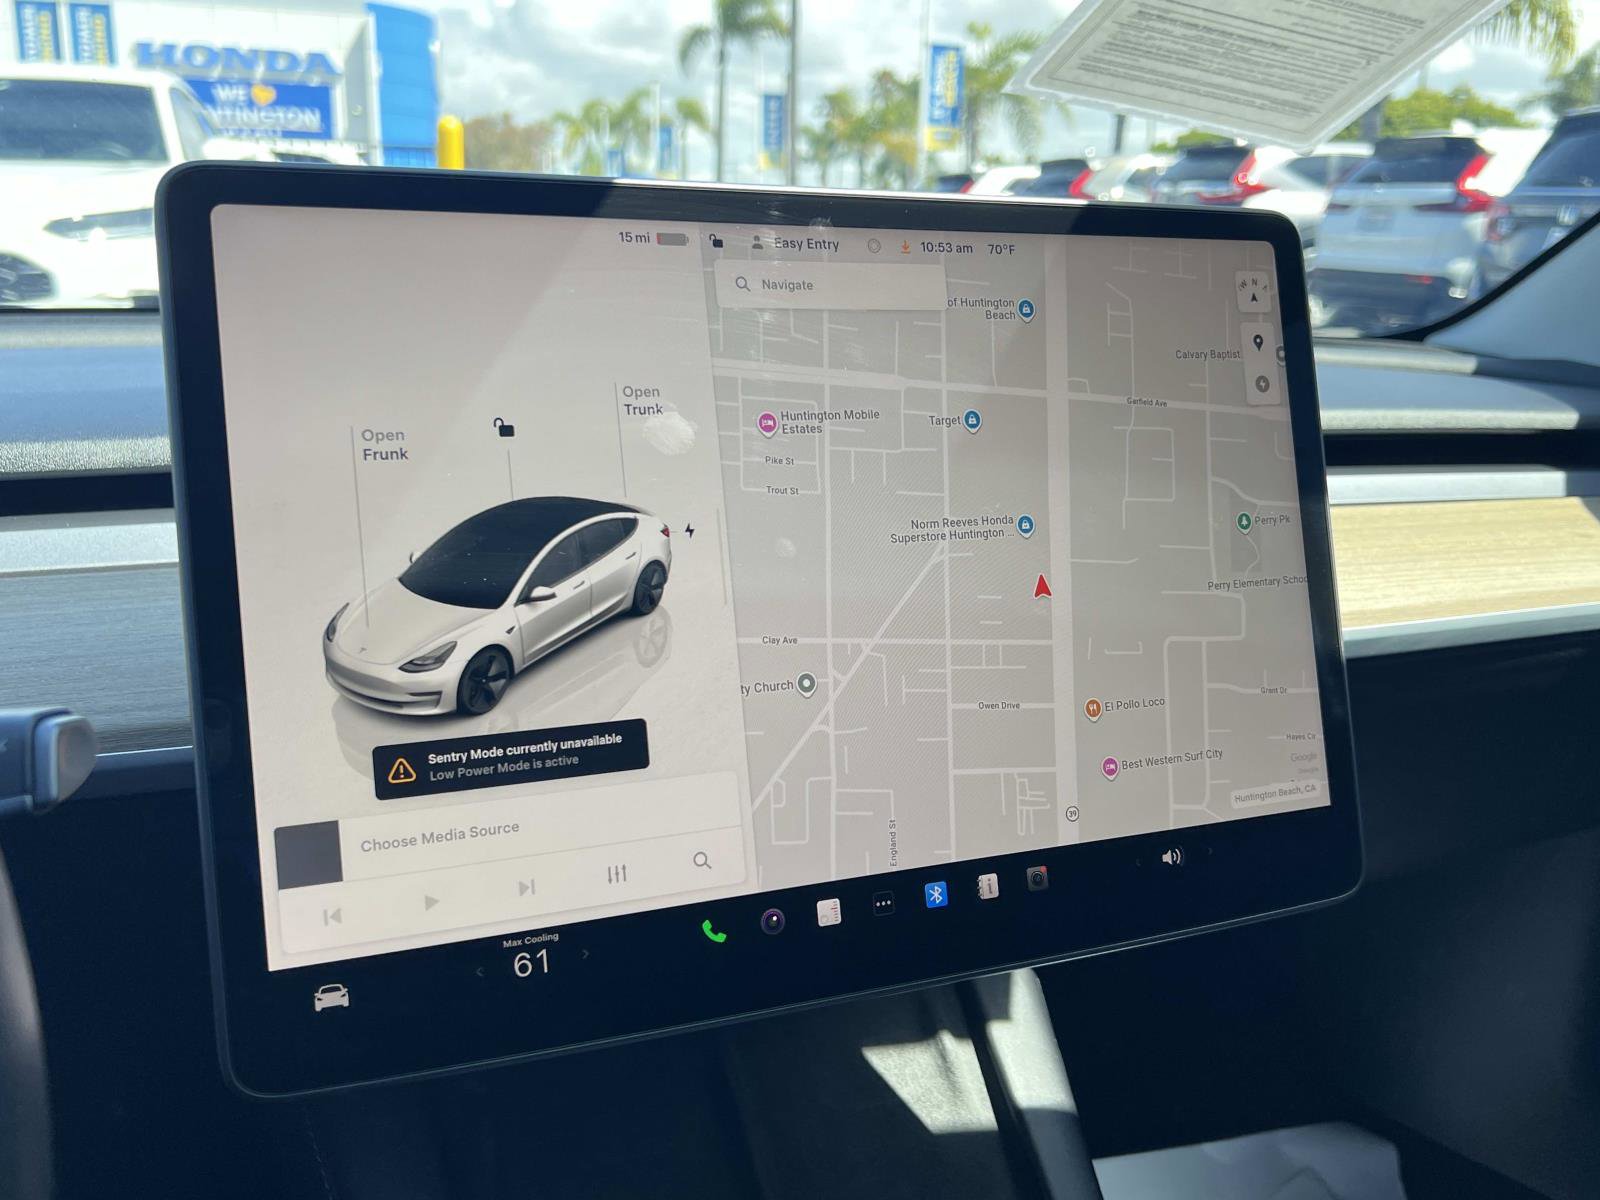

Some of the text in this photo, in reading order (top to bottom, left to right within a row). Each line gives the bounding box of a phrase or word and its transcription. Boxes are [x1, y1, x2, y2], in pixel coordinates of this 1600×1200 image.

[135, 42, 342, 75] HONDA
[212, 84, 248, 102] WE
[619, 231, 651, 244] 15 mi
[774, 237, 839, 252] Easy Entry
[920, 240, 974, 255] 10:53 am
[988, 243, 1015, 256] 70°F
[761, 278, 814, 293] Navigate
[947, 297, 1015, 310] of Huntington
[985, 309, 1016, 320] Beach
[1175, 350, 1241, 361] Calvary Baptist
[623, 385, 661, 399] Open
[624, 403, 663, 416] Trunk
[1155, 399, 1168, 408] Ave
[780, 409, 880, 423] Huntington Mobile
[928, 415, 962, 428] Target
[782, 423, 823, 435] Estates
[361, 428, 405, 445] Open
[363, 447, 409, 461] Frunk
[765, 455, 795, 466] Pike St
[766, 485, 799, 496] Trout St
[911, 515, 1014, 530] Norm Reeves Honda
[1254, 514, 1291, 526] Perry Pk
[890, 531, 947, 545] Superstore
[949, 529, 1005, 542] Huntington
[1207, 580, 1231, 591] Perry
[1233, 577, 1281, 589] Elementary
[762, 635, 798, 645] Clay Ave
[754, 680, 794, 693] Church
[978, 700, 1021, 710] Owen Drive
[1105, 697, 1166, 713] El Pollo Loco
[428, 733, 623, 764] Sentry Mode currently unavailable
[1121, 747, 1223, 771] Best Western Surf City
[429, 753, 580, 783] Low Power Mode is active
[1234, 782, 1317, 803] Huntington Beach, CA
[1068, 808, 1078, 819] 39
[360, 820, 521, 855] Choose Media Source
[889, 818, 898, 868] England St
[502, 931, 560, 949] Max Cooling
[513, 947, 550, 979] 61
